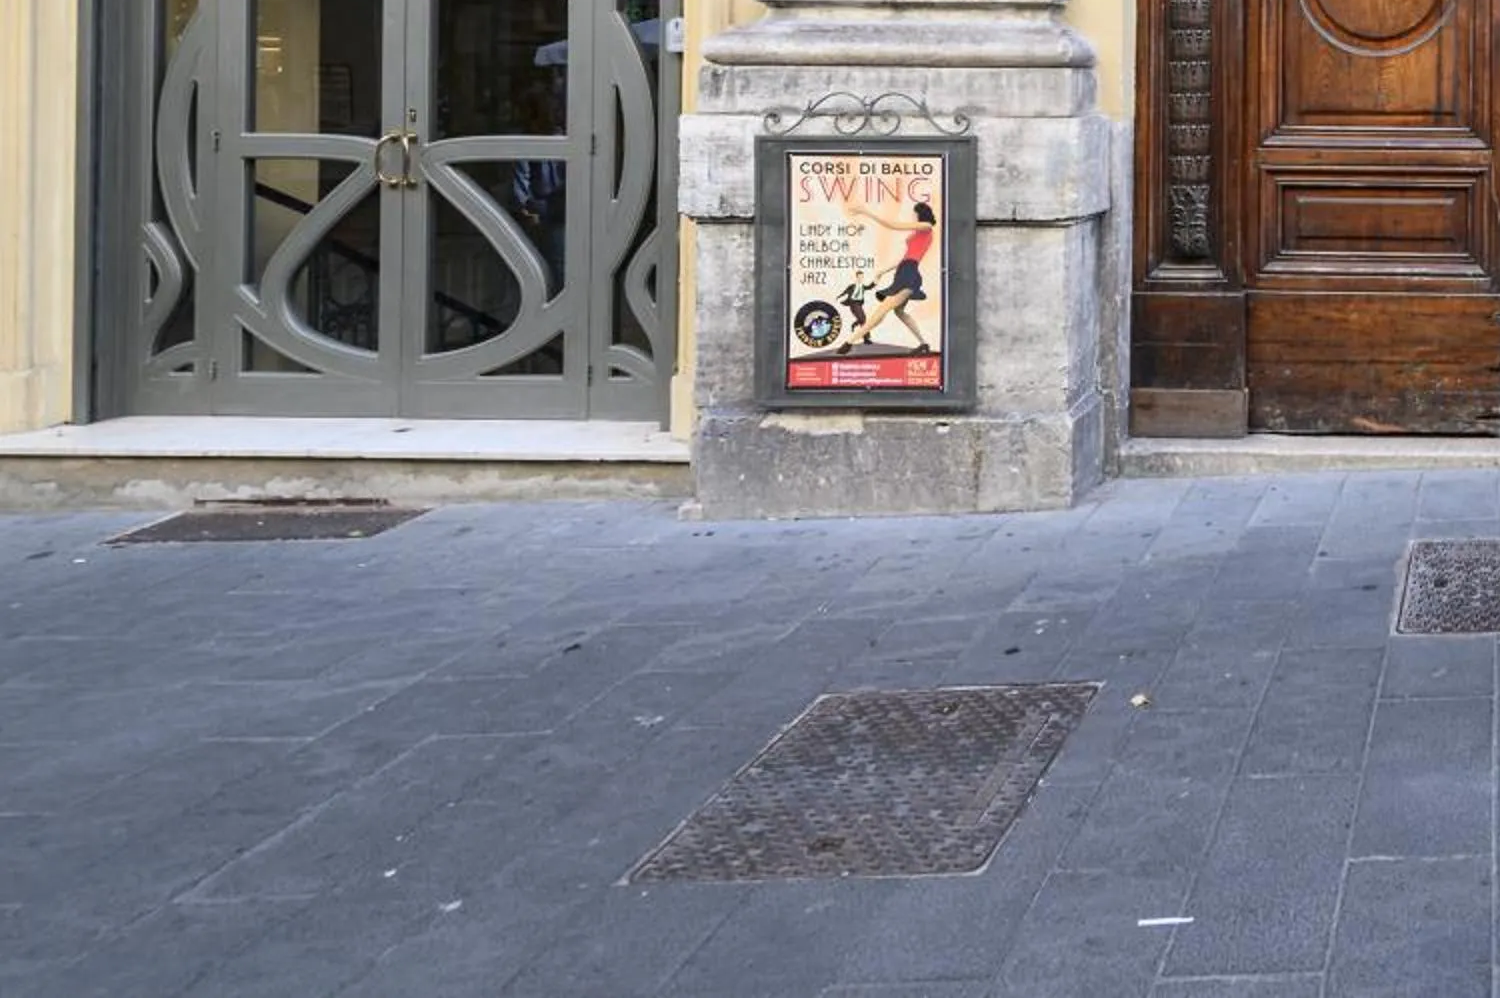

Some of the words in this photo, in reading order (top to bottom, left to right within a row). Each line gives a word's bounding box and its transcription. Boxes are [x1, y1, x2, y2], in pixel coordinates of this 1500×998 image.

[799, 162, 851, 175] CORSI
[859, 163, 876, 175] DI
[881, 163, 934, 175] BALLO
[799, 176, 932, 203] SWING
[799, 239, 850, 253] BALBOA
[799, 255, 875, 269] CHARLESTON
[799, 271, 827, 285] JAZZ
